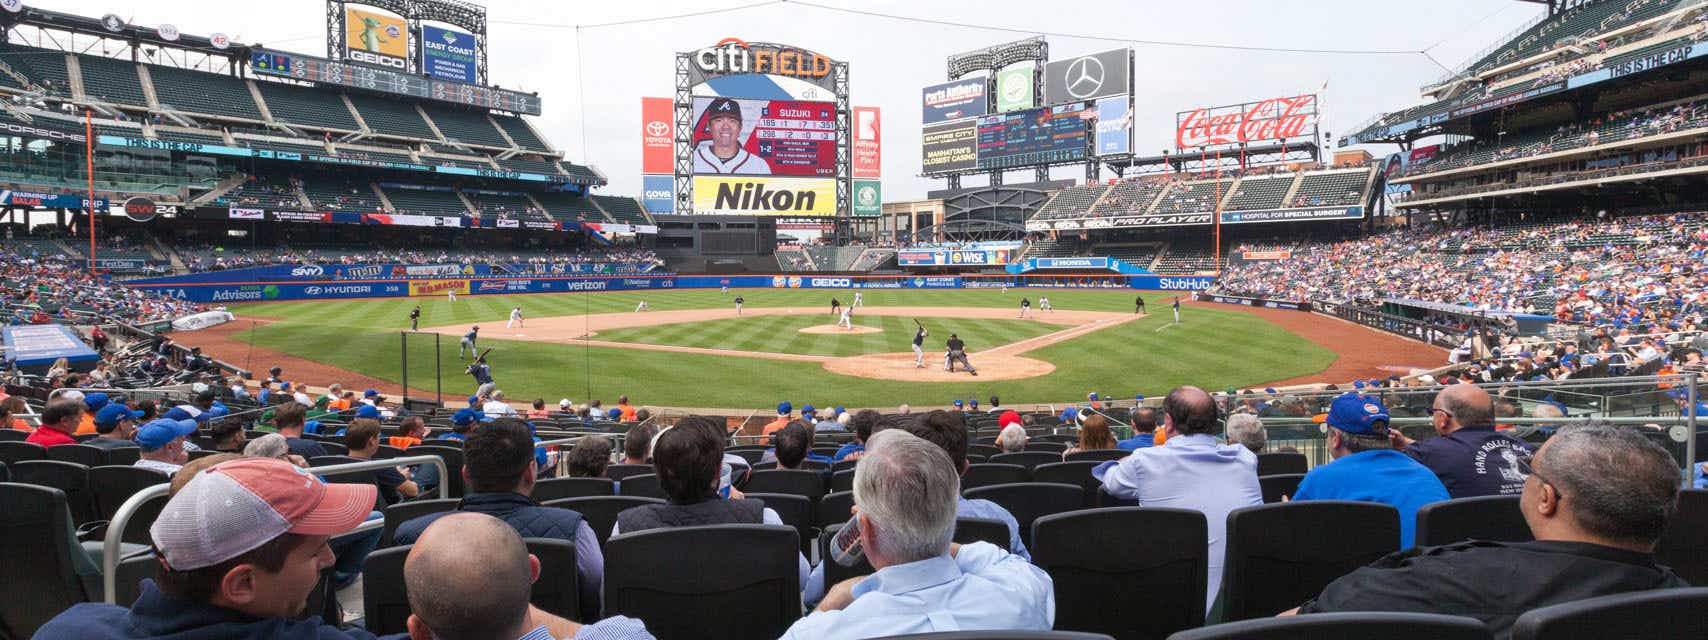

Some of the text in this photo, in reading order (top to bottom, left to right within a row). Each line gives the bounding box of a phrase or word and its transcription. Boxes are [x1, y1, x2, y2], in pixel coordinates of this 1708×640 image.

[425, 41, 473, 56] EAST COAST
[351, 50, 404, 68] GEICO
[697, 43, 831, 77] citi FIELD
[1609, 46, 1693, 77] THIS IS THE CAP
[779, 109, 811, 118] SUZUKI
[0, 123, 86, 142] PORSCHE
[926, 129, 974, 142] EMPIRE CITY
[126, 138, 204, 151] THIS IS THE CAP
[645, 136, 672, 144] TOYOTA
[12, 191, 47, 200] WARMING
[715, 182, 817, 211] Nikon
[127, 205, 153, 213] SW
[1241, 211, 1270, 219] HOSPITAL
[1313, 209, 1347, 217] SURGERY
[1114, 217, 1146, 225] PRO
[1146, 215, 1210, 224] PLAYER
[962, 252, 985, 263] WISE
[291, 267, 319, 276] SNY
[568, 280, 606, 290] verizon
[812, 278, 850, 287] GEICO
[1160, 278, 1210, 289] StubHub
[213, 289, 262, 301] Advisors
[324, 286, 371, 294] HYUNDAI
[1475, 450, 1487, 474] HAND
